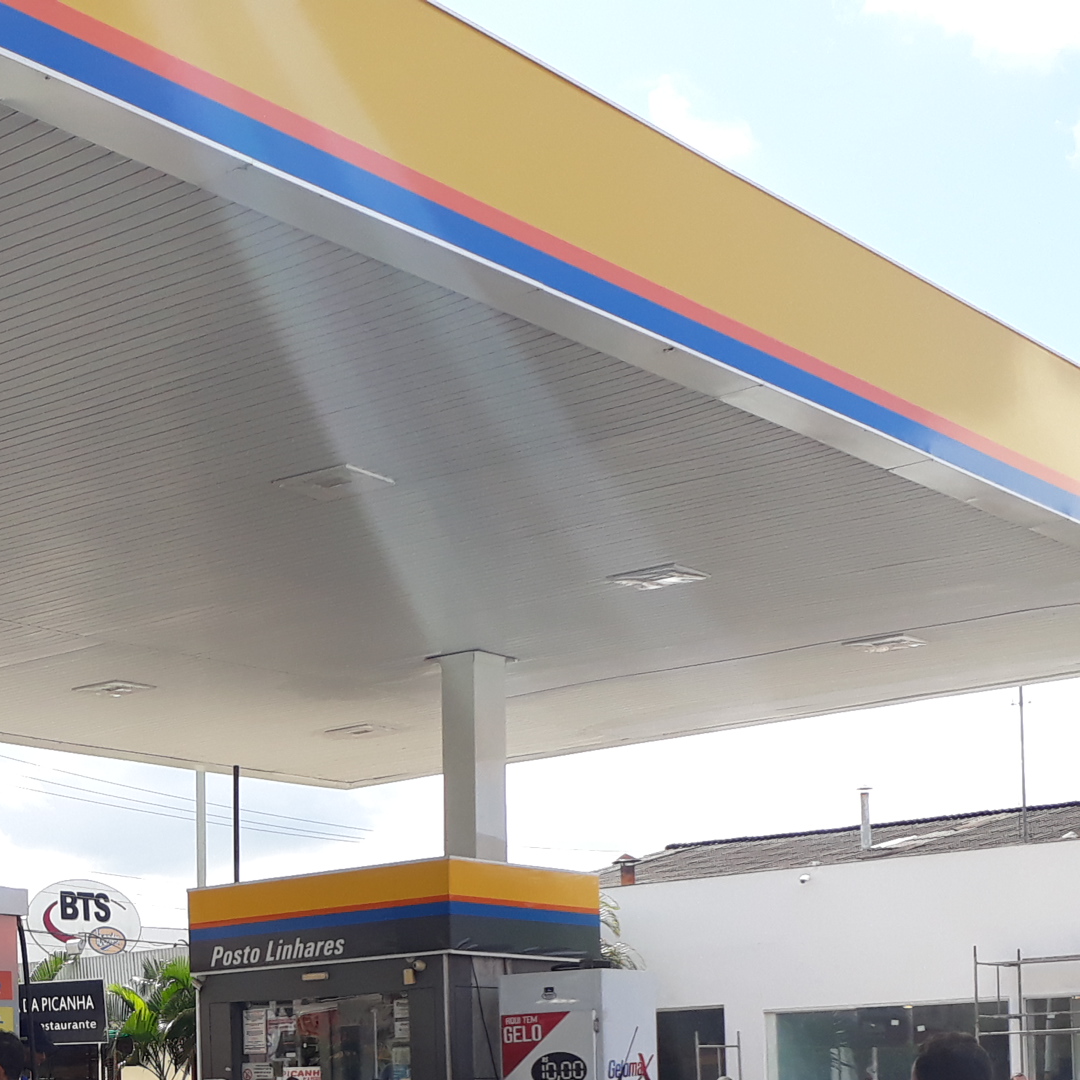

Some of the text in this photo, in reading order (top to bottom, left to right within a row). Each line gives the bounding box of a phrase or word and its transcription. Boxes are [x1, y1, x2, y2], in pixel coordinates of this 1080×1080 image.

[60, 890, 111, 922] BTS
[211, 937, 345, 968] Posto Linhares
[41, 995, 94, 1012] PICANHA
[505, 1016, 521, 1025] AQUI
[503, 1025, 542, 1043] GELO
